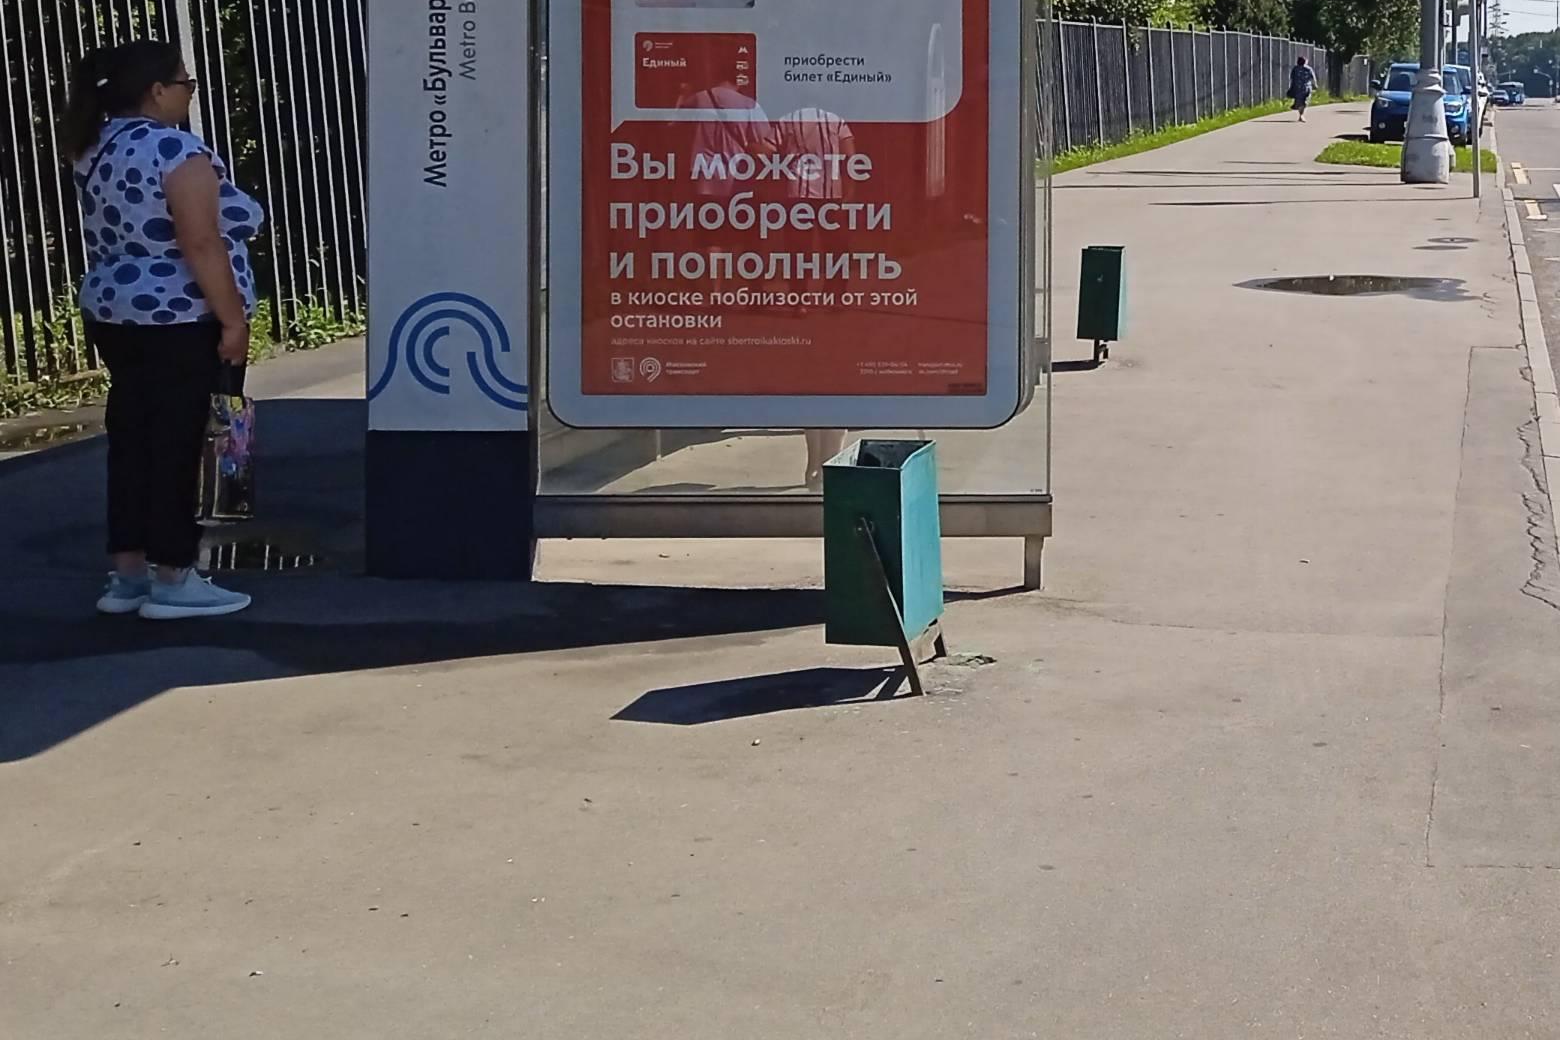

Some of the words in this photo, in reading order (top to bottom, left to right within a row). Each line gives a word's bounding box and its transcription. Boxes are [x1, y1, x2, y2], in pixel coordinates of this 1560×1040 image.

[457, 20, 477, 81] Metro
[642, 56, 687, 69] Единый
[783, 54, 865, 68] приобрести
[783, 70, 824, 82] билет
[826, 70, 892, 83] «Единый»
[423, 109, 453, 188] Метро
[609, 142, 676, 181] Вы
[691, 151, 873, 182] можете
[609, 192, 893, 238] приобрести
[609, 252, 635, 280] и
[650, 251, 903, 281] пополнить
[610, 291, 622, 306] в
[627, 291, 704, 306] киоске
[710, 286, 835, 306] поблизости
[841, 291, 864, 306] от
[871, 288, 918, 306] этой
[610, 314, 722, 329] остановки
